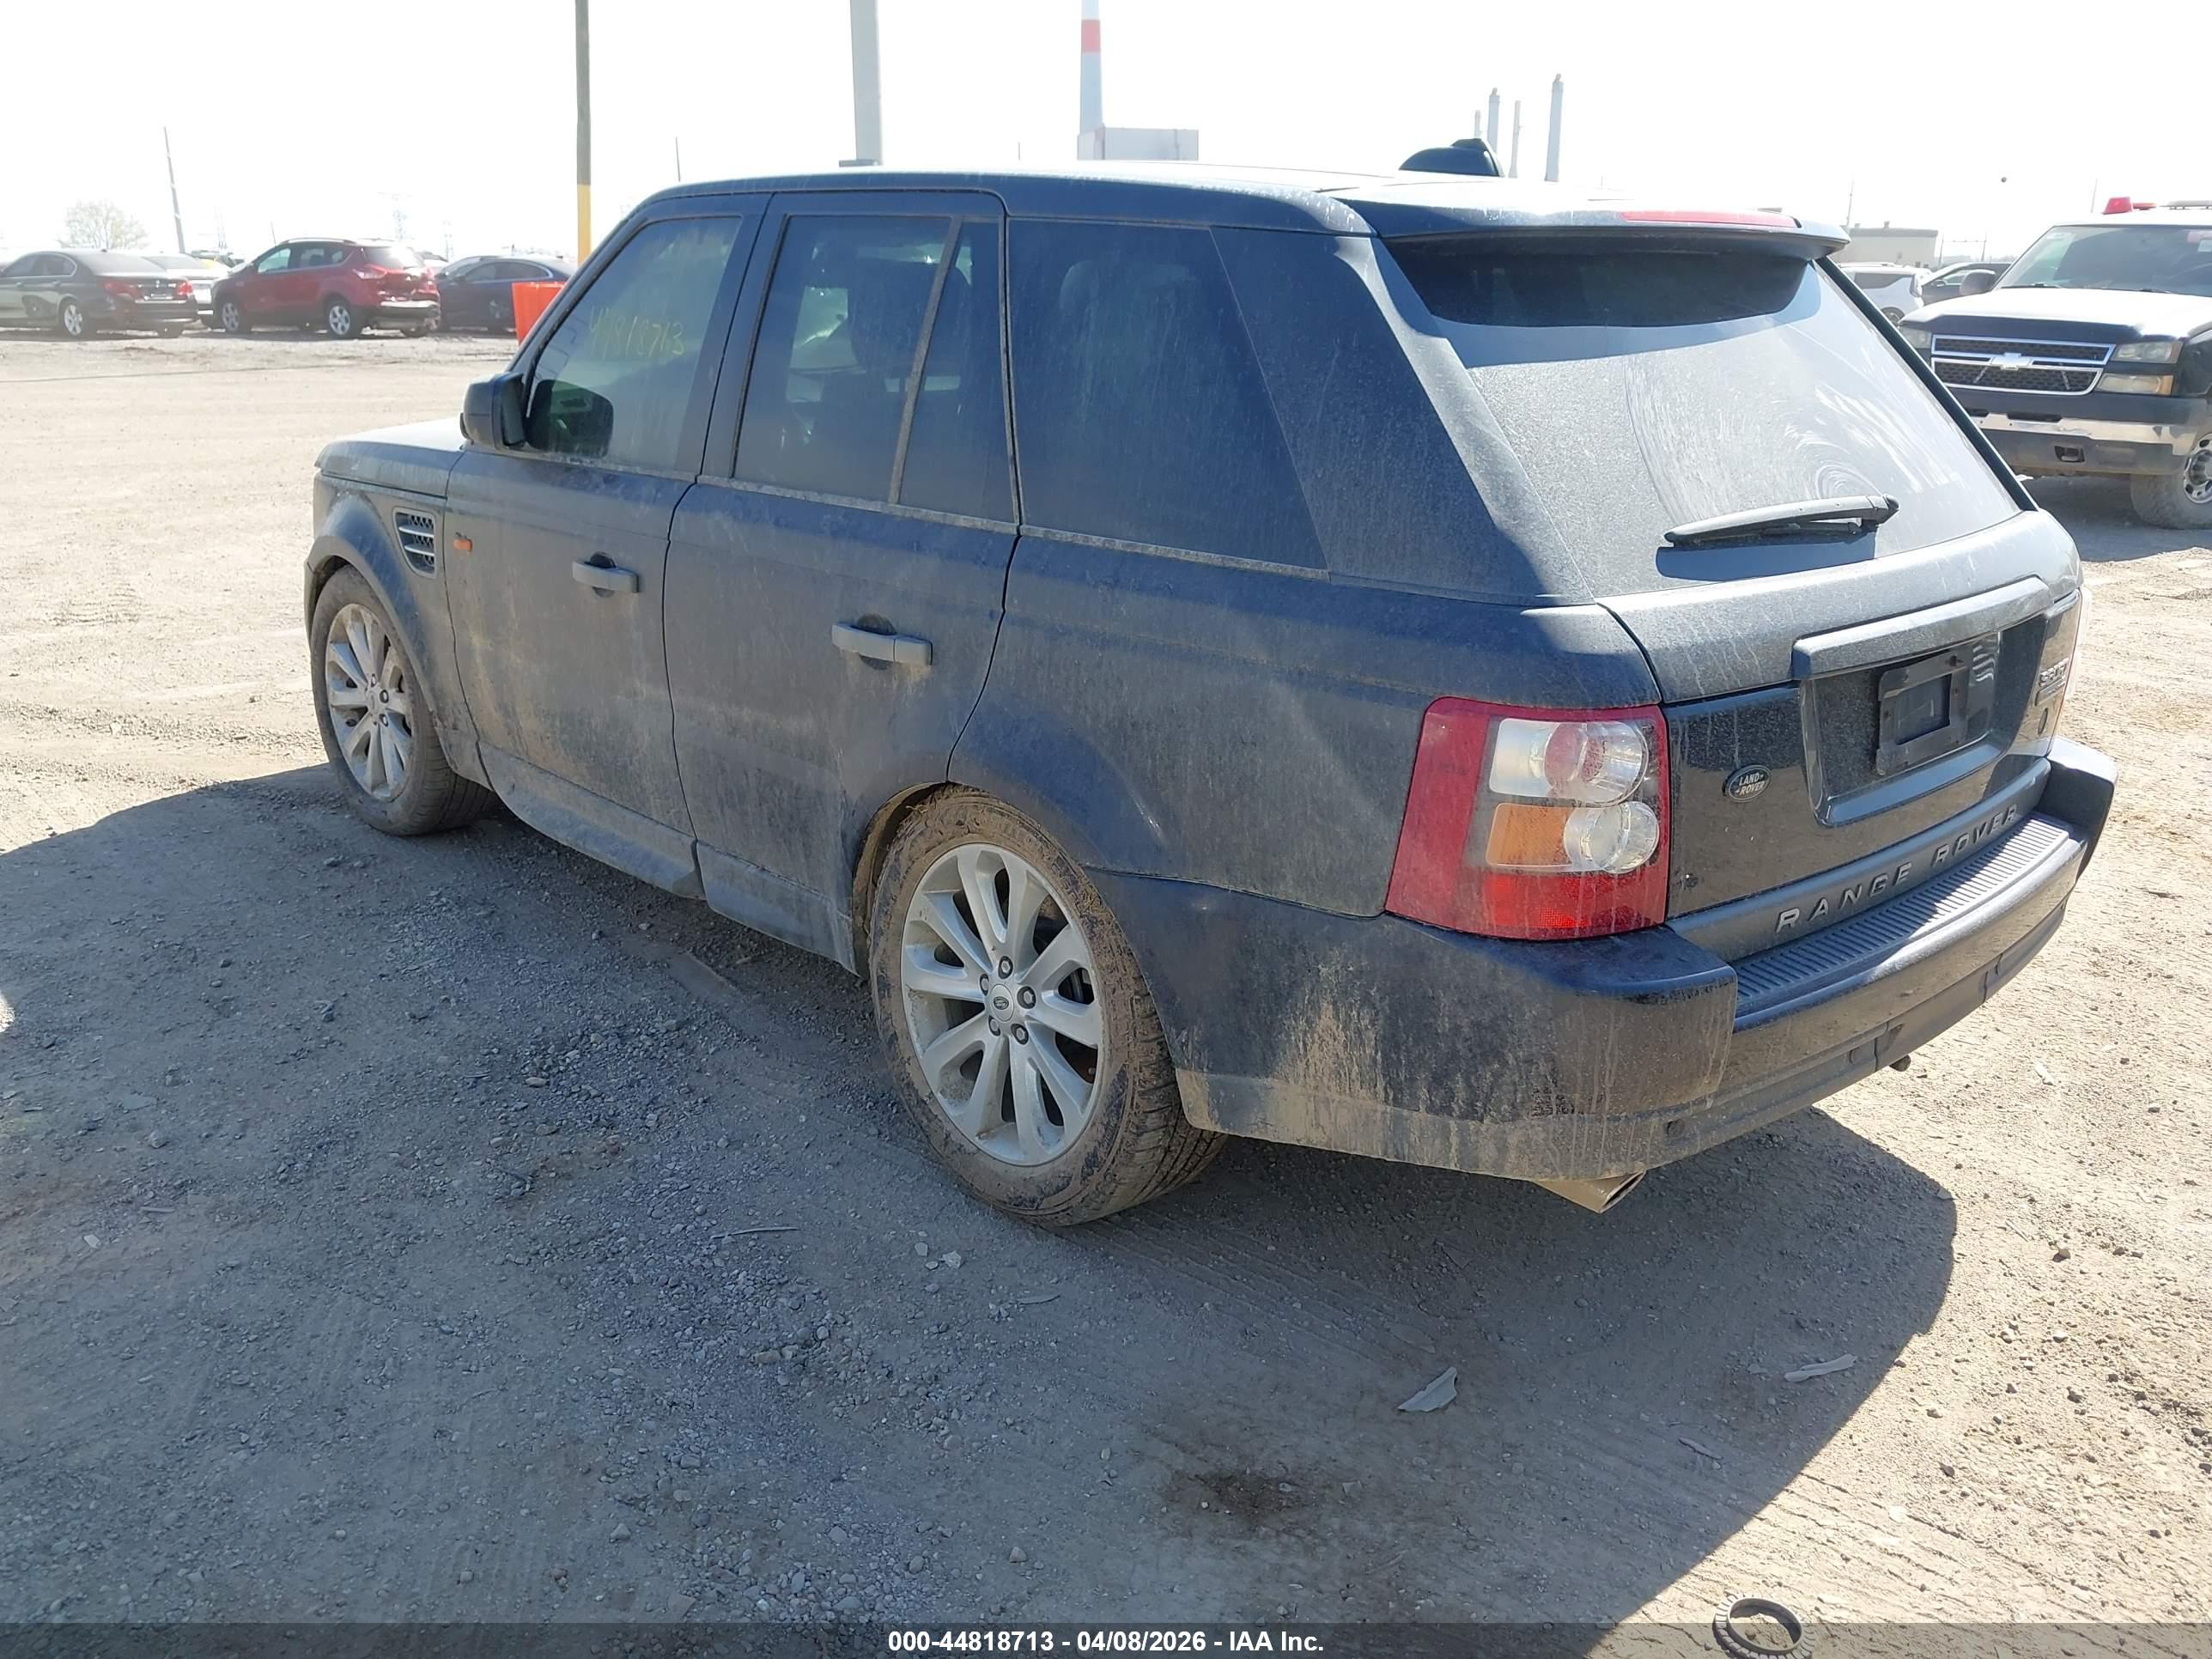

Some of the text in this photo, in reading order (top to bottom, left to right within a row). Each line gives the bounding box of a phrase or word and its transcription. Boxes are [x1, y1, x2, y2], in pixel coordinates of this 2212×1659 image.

[1739, 772, 1759, 786] LAND
[1740, 781, 1765, 795] ROVER
[1776, 804, 2018, 933] RANGE ROVER
